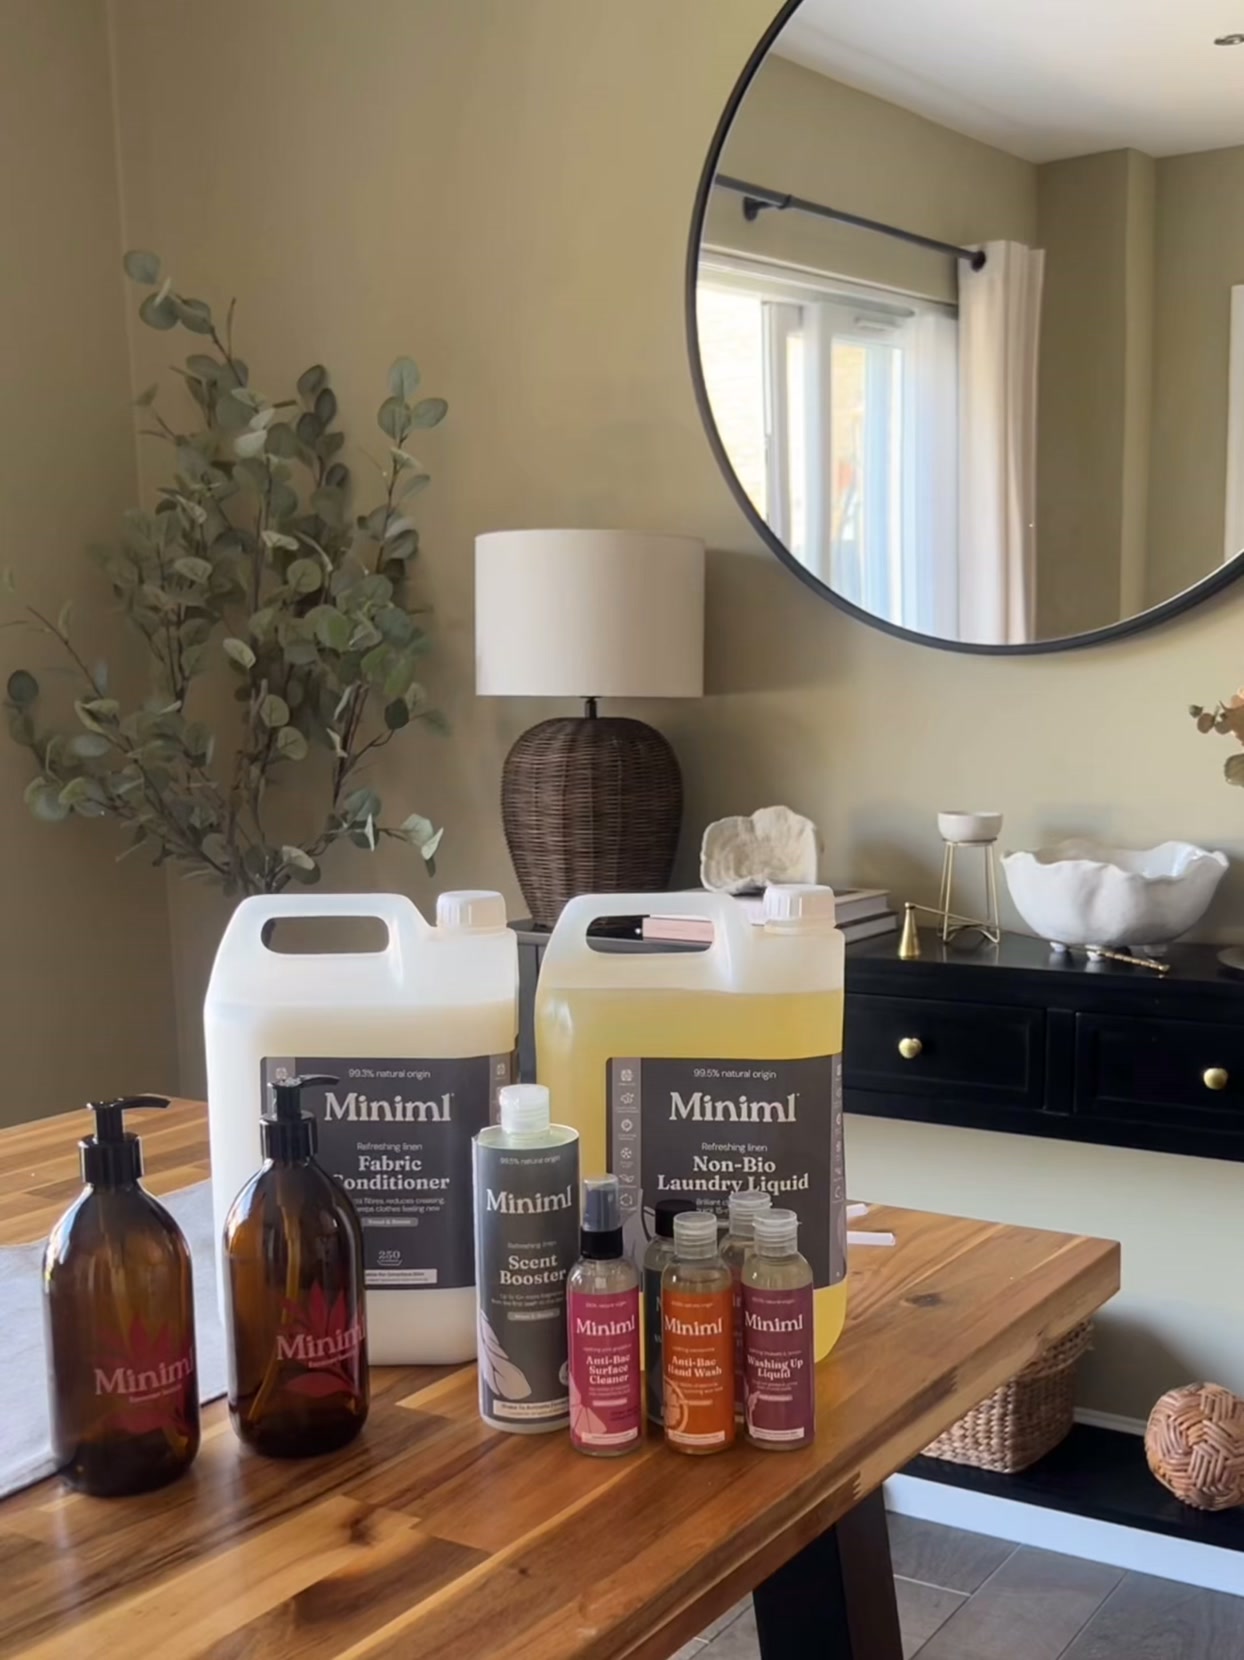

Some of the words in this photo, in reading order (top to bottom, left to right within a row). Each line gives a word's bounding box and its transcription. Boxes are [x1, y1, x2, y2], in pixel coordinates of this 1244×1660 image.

[376, 1069, 406, 1078] natural
[406, 1069, 431, 1080] origin
[693, 1069, 720, 1079] 99.5%
[721, 1069, 751, 1079] natural
[752, 1070, 777, 1081] origin
[324, 1092, 452, 1122] Miniml
[669, 1091, 797, 1123] Miniml
[356, 1142, 401, 1153] Refreshing
[402, 1142, 423, 1151] linen
[701, 1142, 746, 1154] Refreshing
[747, 1143, 768, 1153] linen
[358, 1155, 423, 1172] Fabric
[692, 1156, 777, 1174] Non-Bio
[657, 1175, 743, 1193] Laundry
[749, 1173, 810, 1196] Liquid
[486, 1184, 572, 1214] Miniml
[378, 1250, 401, 1260] 250
[508, 1254, 558, 1270] Scent
[500, 1269, 567, 1286] Booster
[576, 1314, 635, 1336] Miniml
[664, 1314, 723, 1336] Miniml
[745, 1310, 803, 1332] Miniml
[586, 1354, 631, 1365] Anti-Bac
[672, 1355, 717, 1367] Anti-Bac
[747, 1354, 788, 1370] Washing
[789, 1358, 804, 1369] Up
[589, 1364, 629, 1375] Surface
[667, 1364, 692, 1377] Hand
[693, 1365, 722, 1378] Wash
[757, 1368, 791, 1381] Liquid
[589, 1374, 629, 1385] Cleaner
